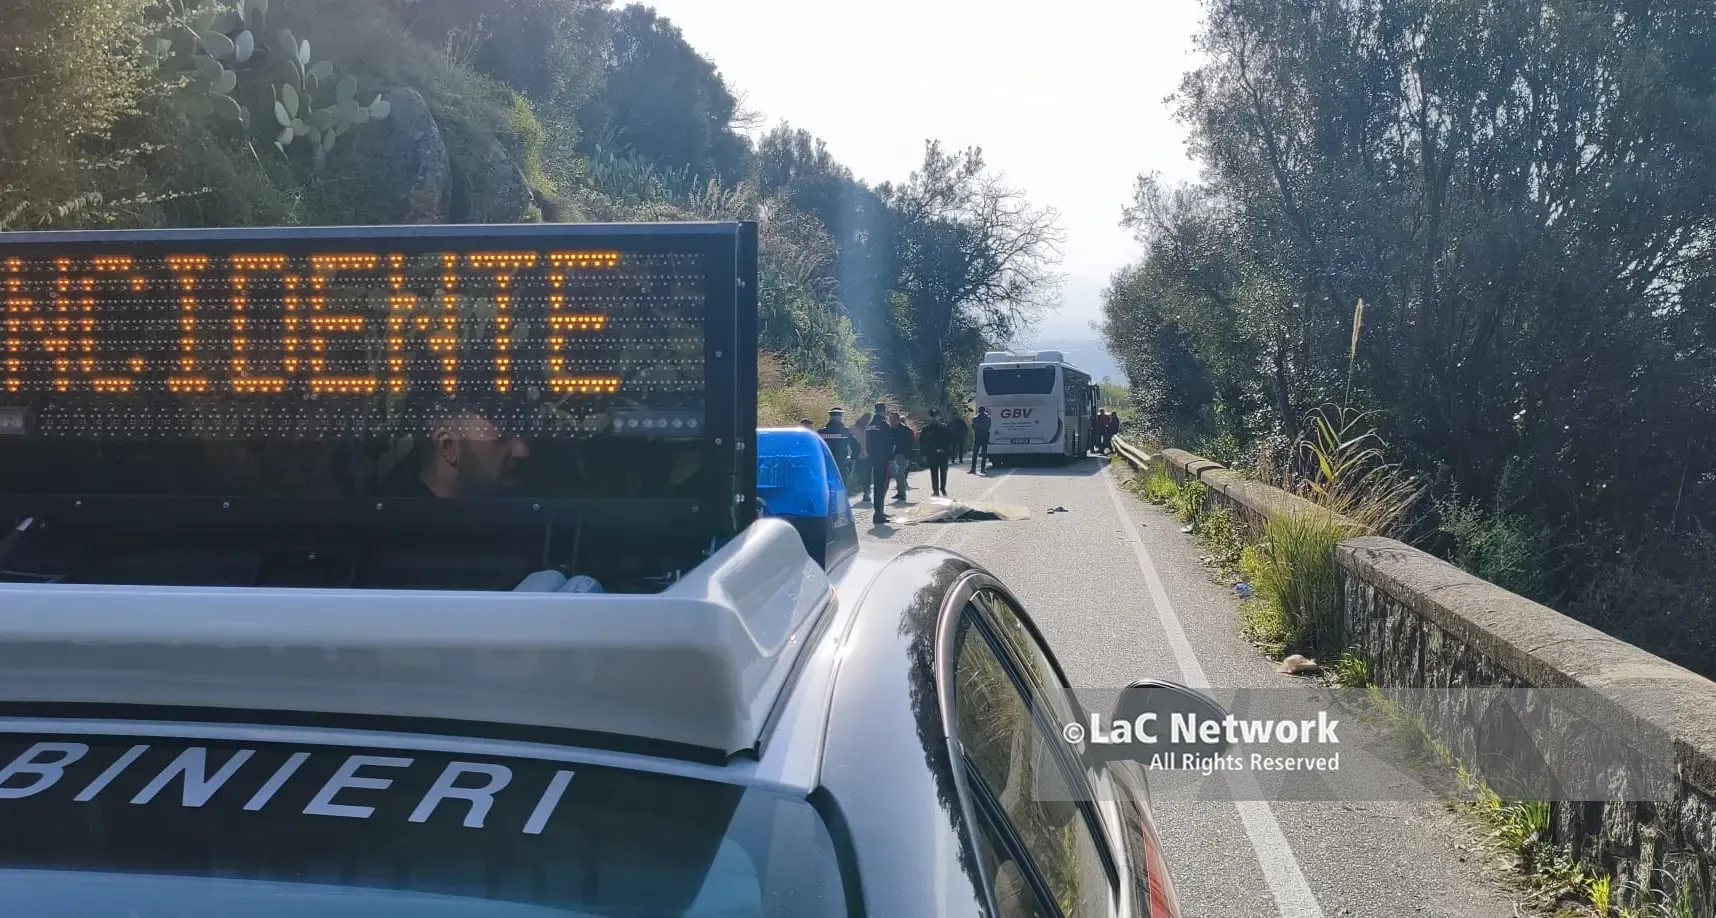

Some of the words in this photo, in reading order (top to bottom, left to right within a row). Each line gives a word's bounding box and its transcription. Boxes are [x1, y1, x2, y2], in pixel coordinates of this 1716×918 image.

[6, 250, 621, 394] NCIDENTE
[1000, 408, 1034, 419] GBV
[0, 741, 576, 835] BINIERI
